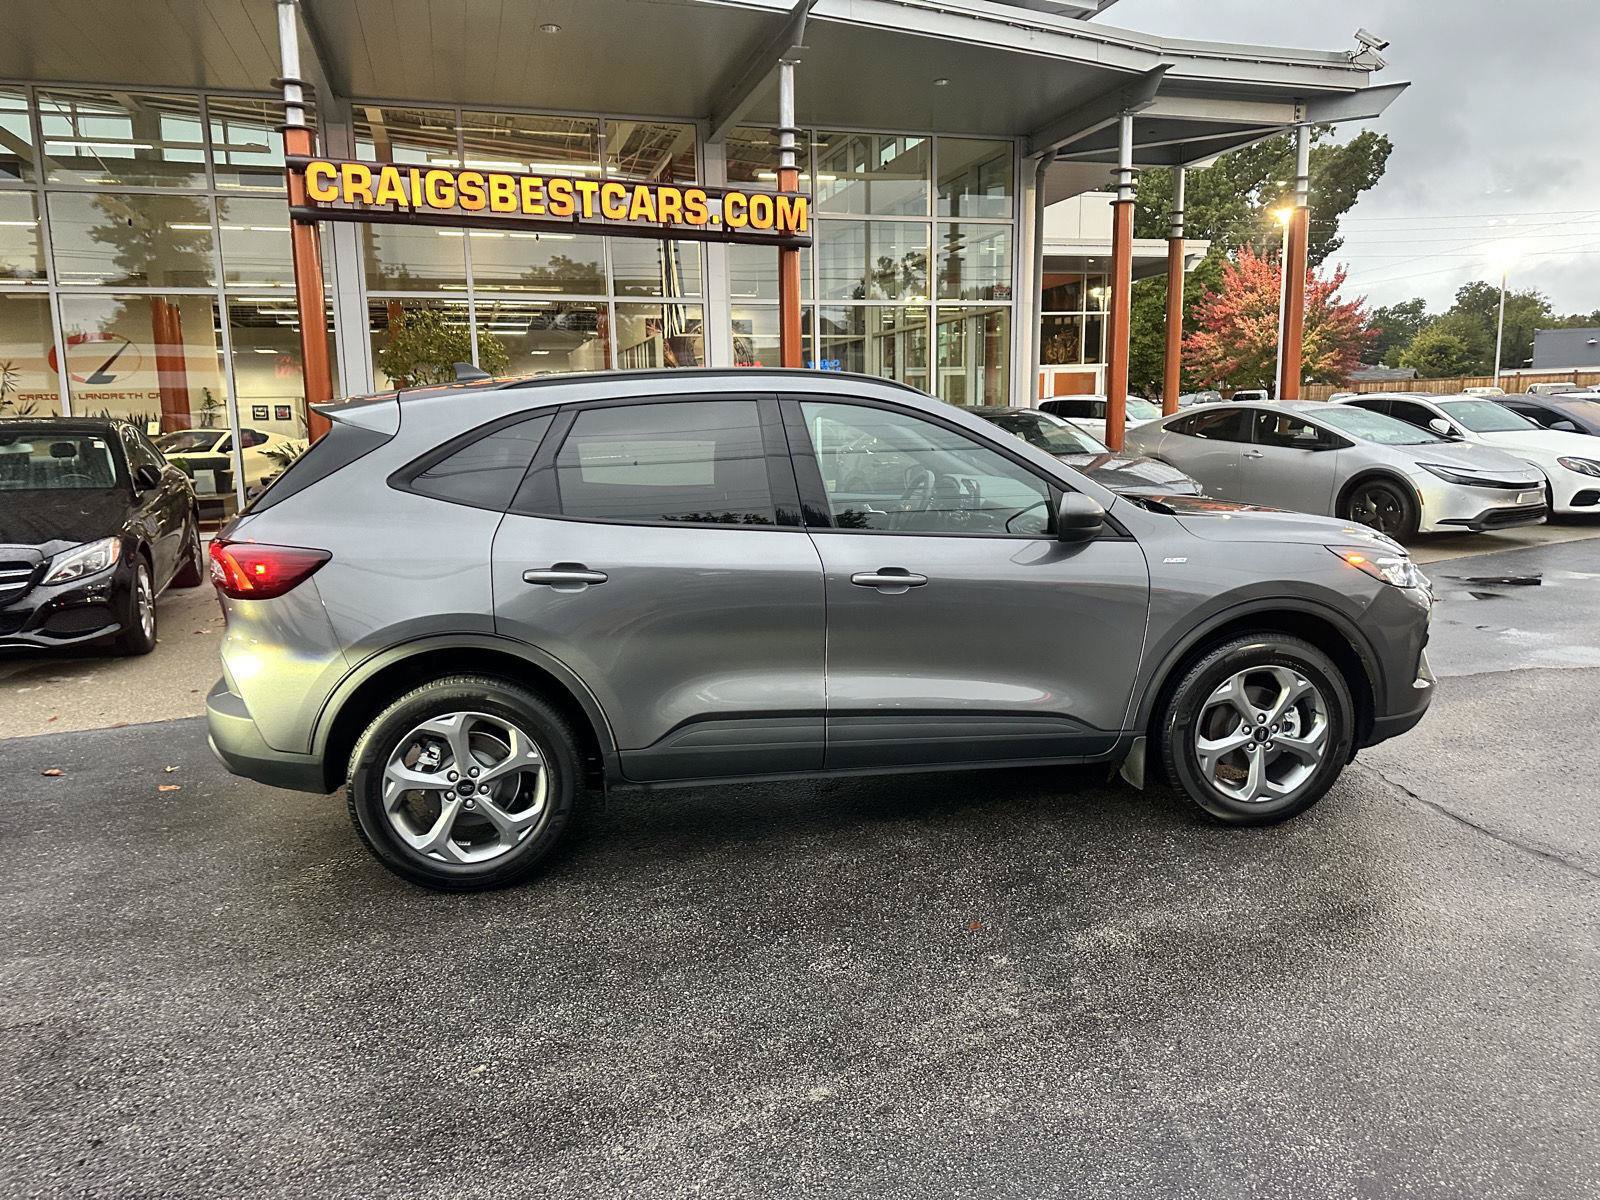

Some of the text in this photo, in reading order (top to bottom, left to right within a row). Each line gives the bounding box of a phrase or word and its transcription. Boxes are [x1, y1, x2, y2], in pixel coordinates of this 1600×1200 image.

[305, 161, 808, 232] CRAIGSBESTCARS.COM
[17, 393, 59, 401] CRAIG
[77, 392, 144, 400] LANDRETH
